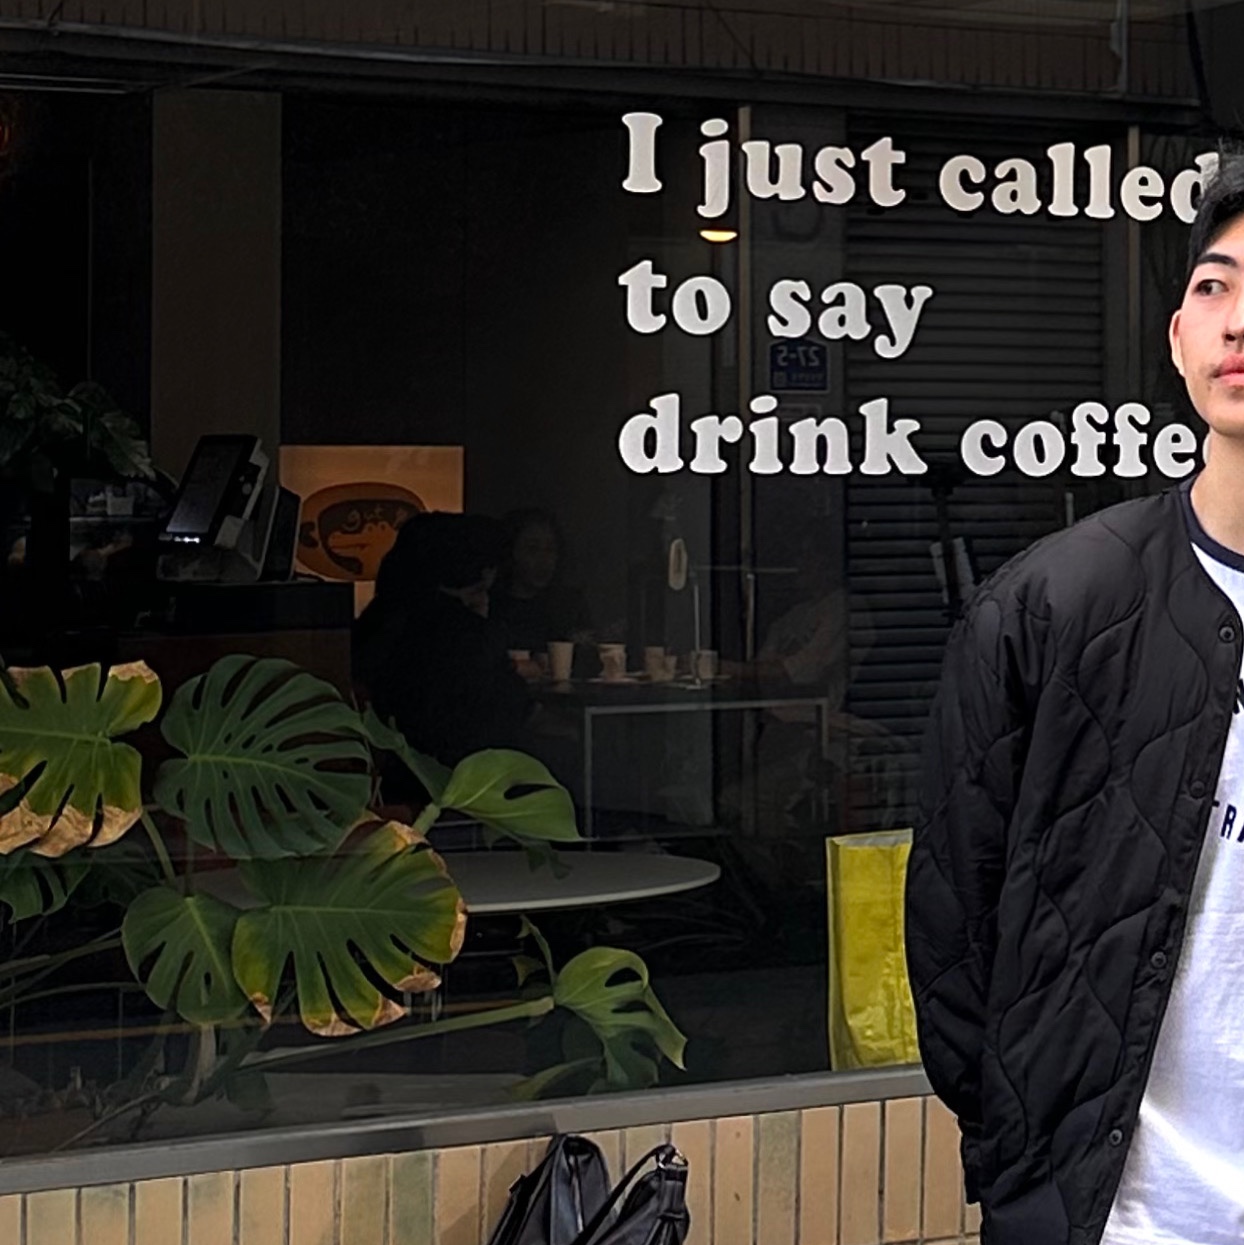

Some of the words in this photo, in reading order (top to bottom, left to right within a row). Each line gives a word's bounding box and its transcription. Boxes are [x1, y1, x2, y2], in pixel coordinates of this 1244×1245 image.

[622, 112, 662, 192] I
[697, 119, 905, 217] just
[940, 143, 1219, 223] called
[619, 260, 730, 334] to
[768, 280, 932, 358] say
[619, 393, 928, 474] drink
[961, 402, 1209, 478] coffe
